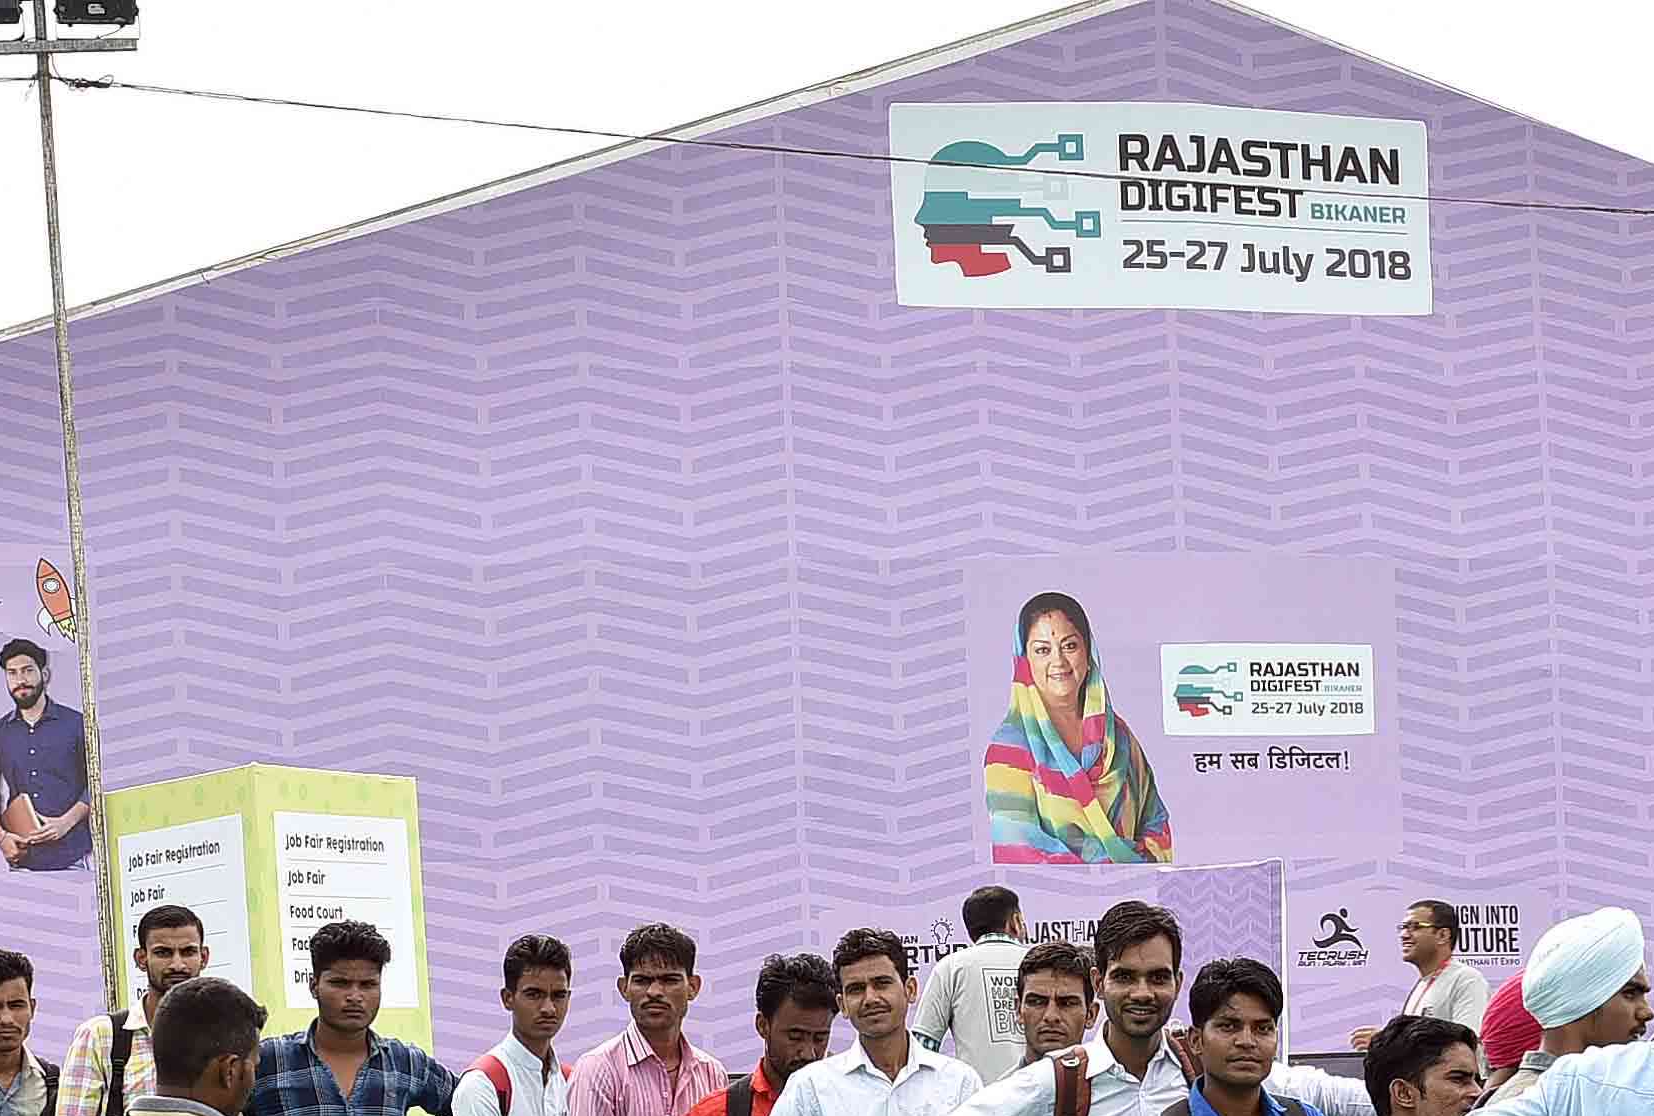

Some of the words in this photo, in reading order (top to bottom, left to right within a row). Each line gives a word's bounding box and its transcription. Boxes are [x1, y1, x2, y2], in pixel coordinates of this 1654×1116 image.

[1118, 134, 1399, 185] RAJASTHAN
[1121, 180, 1304, 219] DIGIFEST
[1310, 202, 1406, 225] BIKANER
[1122, 240, 1228, 271] 25-27
[1240, 242, 1314, 282] July
[1325, 248, 1411, 281] 2018
[1250, 662, 1359, 677] RAJASTHAN
[1251, 680, 1322, 692] DIGIFEST
[1251, 702, 1292, 714] 25-27
[1296, 702, 1326, 716] July
[1330, 702, 1364, 714] 2018
[1194, 752, 1222, 771] हम
[1231, 752, 1260, 770] सब
[1267, 745, 1350, 770] डिजिटल!
[285, 833, 302, 850] Job
[305, 834, 324, 849] Fair
[326, 835, 385, 853] Registration
[128, 854, 144, 872] Job
[145, 849, 163, 866] Fair
[165, 840, 220, 863] Registration
[288, 869, 305, 886] Job
[306, 869, 326, 885] Fair
[131, 890, 146, 907] Job
[147, 884, 165, 901] Fair
[290, 905, 314, 919] Food
[316, 906, 343, 920] Court
[1485, 905, 1519, 925] INTO
[1458, 927, 1520, 953] UTURE
[1298, 950, 1368, 961] TECRUSH
